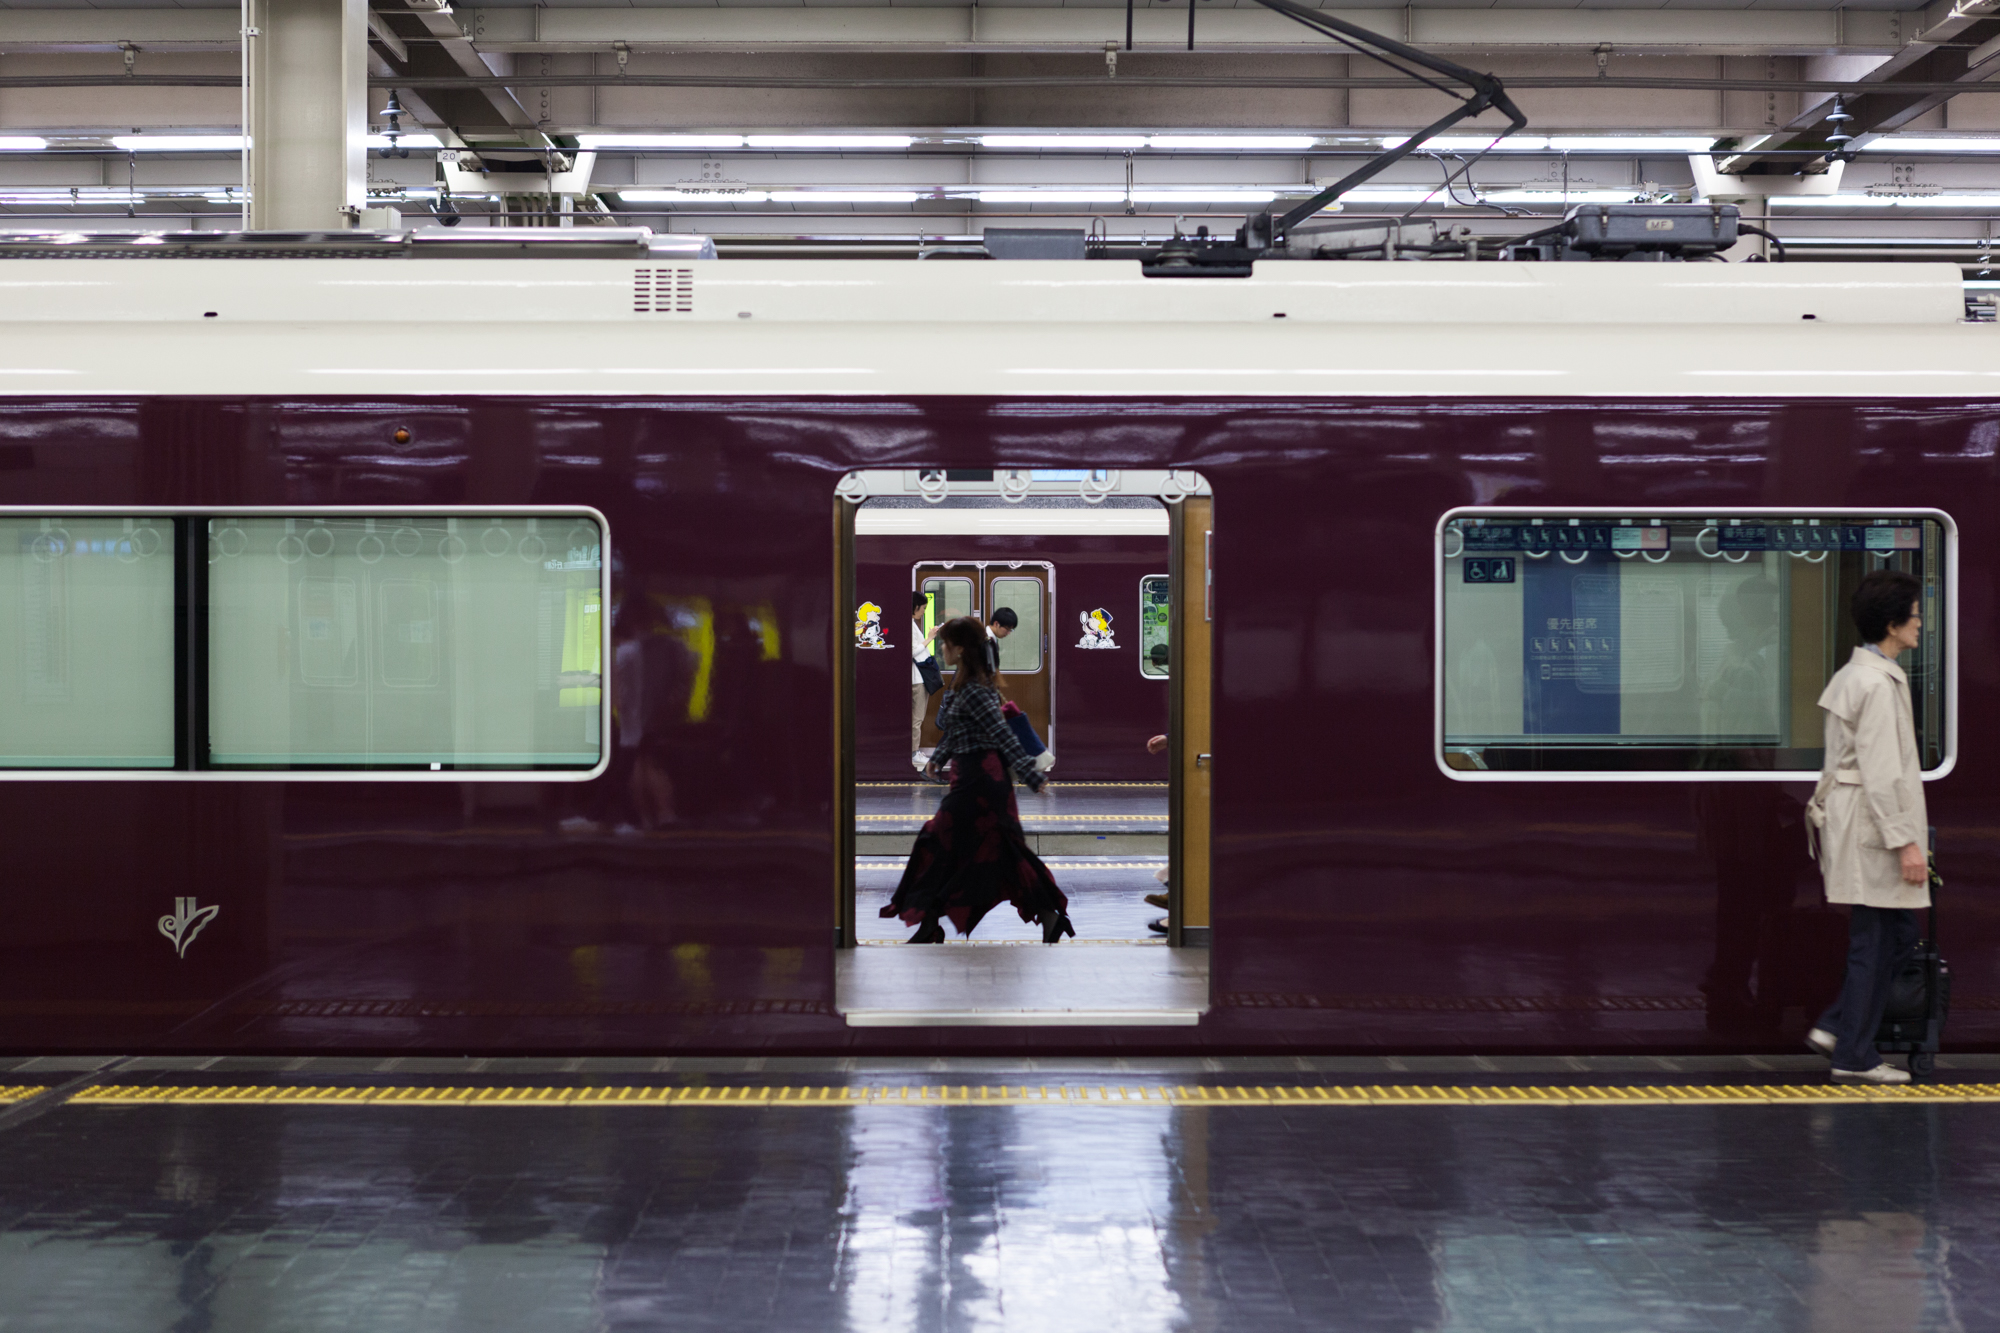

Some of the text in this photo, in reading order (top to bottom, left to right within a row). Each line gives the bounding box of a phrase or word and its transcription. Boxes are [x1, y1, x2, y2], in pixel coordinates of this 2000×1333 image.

[442, 152, 456, 160] 20
[1547, 617, 1597, 630] 優先座席
